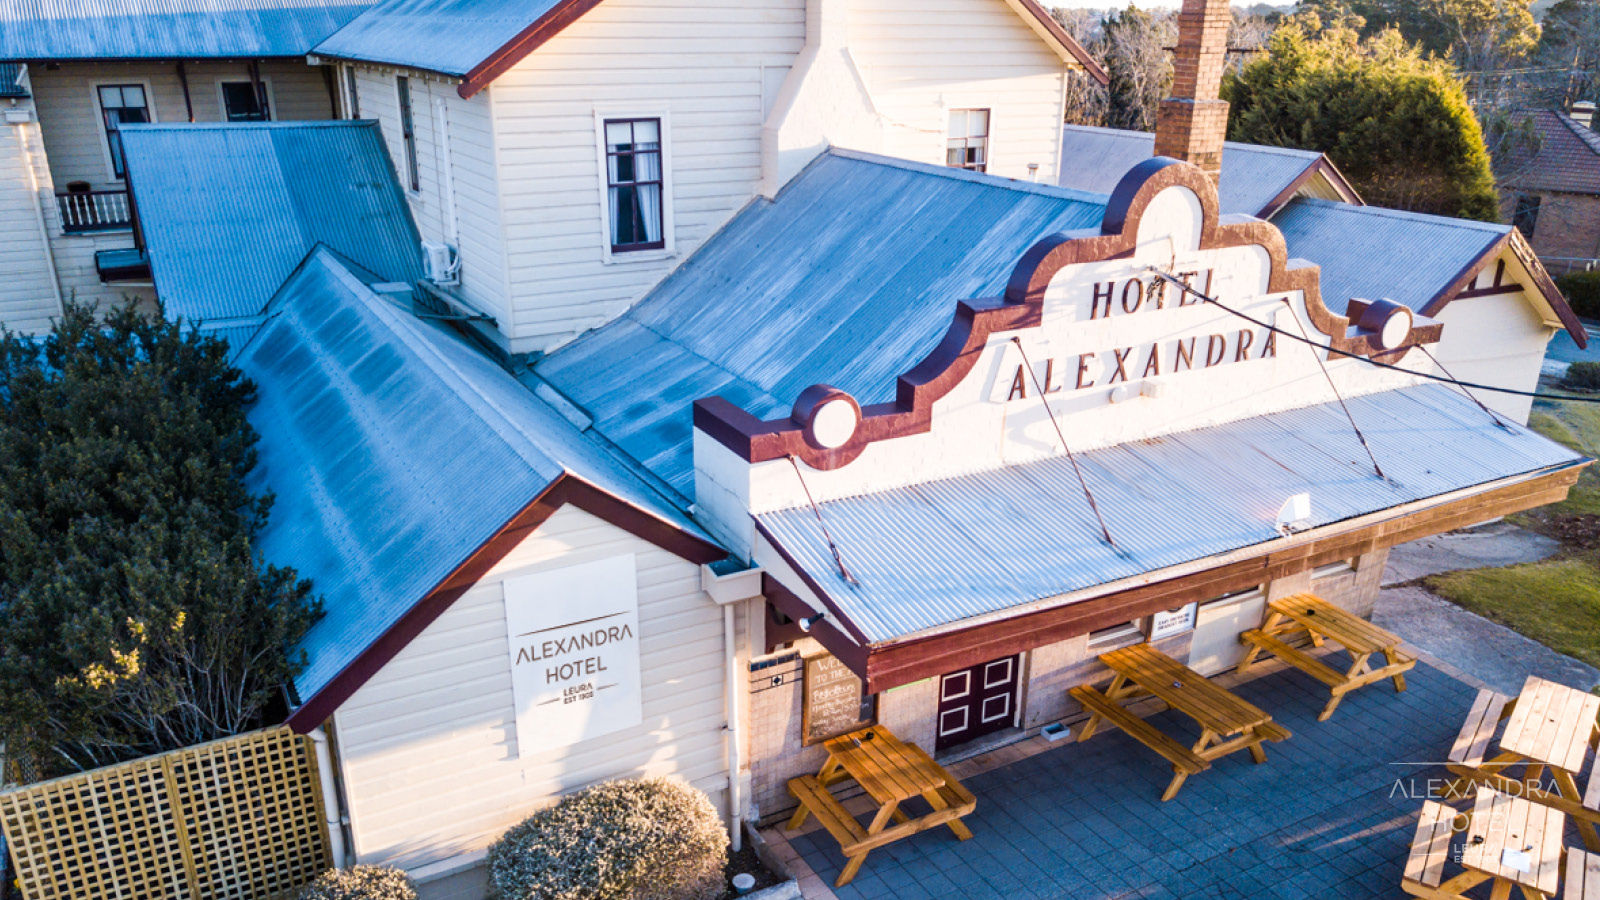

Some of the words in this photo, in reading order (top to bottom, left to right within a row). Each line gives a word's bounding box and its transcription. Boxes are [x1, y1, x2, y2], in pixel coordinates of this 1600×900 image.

[1090, 268, 1219, 320] HOTEL
[1008, 323, 1277, 401] ALEXANDRA
[515, 624, 633, 666] ALEXANDRA
[546, 656, 607, 684] HOTEL
[829, 668, 846, 680] THE
[563, 682, 593, 696] LEURA
[563, 695, 577, 704] EST
